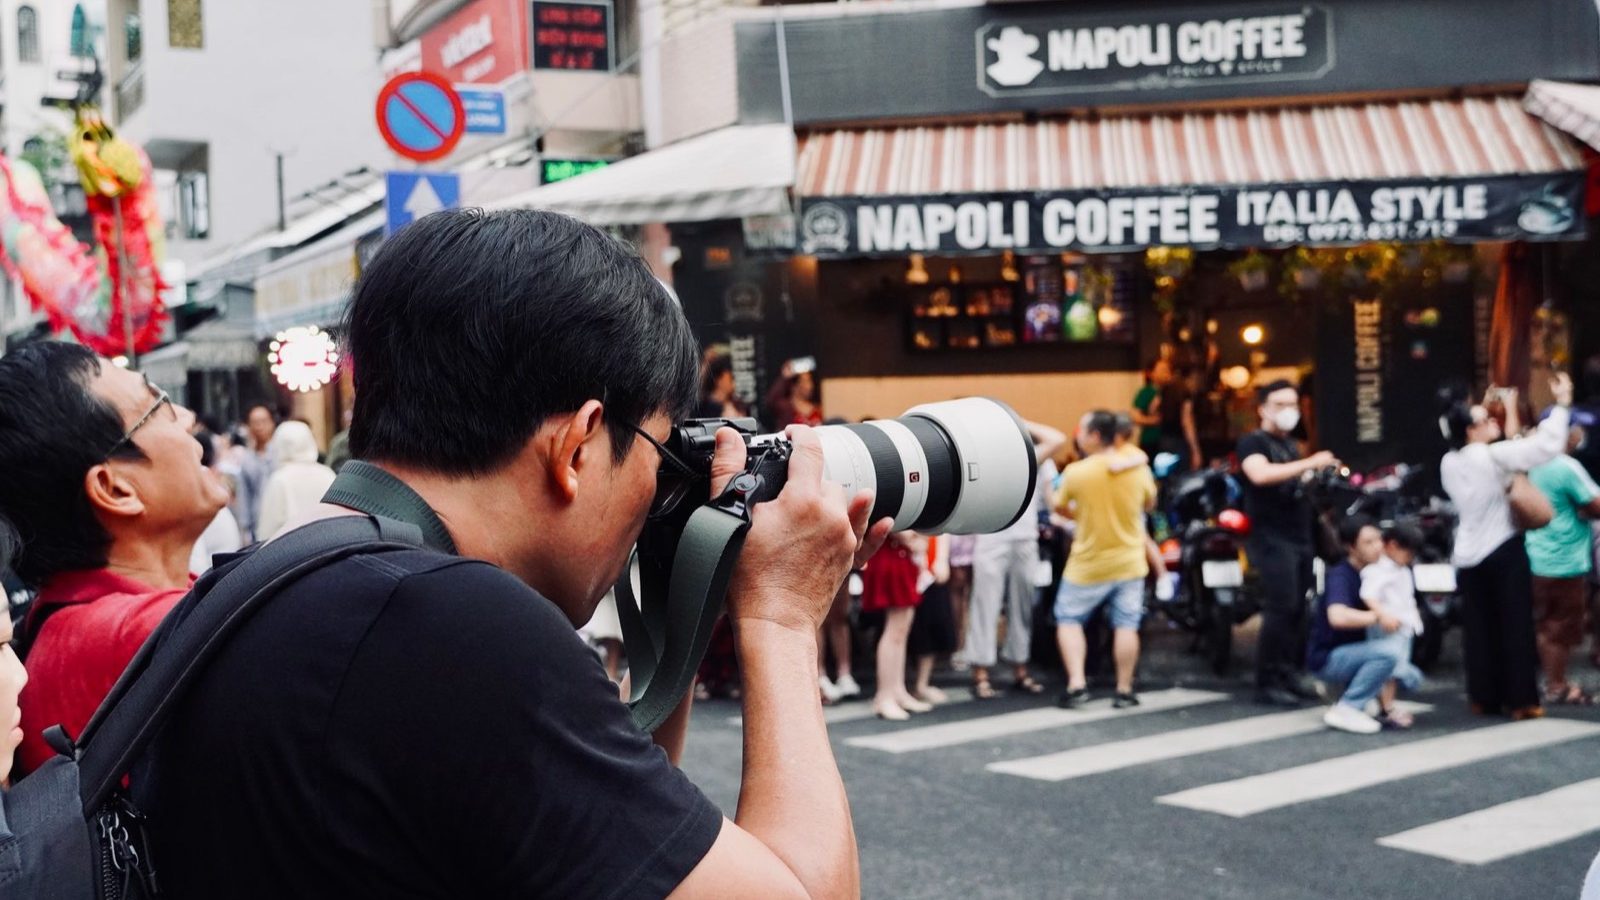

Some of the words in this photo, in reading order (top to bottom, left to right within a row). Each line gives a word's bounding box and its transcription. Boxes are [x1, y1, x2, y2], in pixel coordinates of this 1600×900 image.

[1047, 23, 1171, 71] NAPOLI
[1177, 14, 1307, 65] COFFEE
[857, 200, 1030, 252] NAPOLI
[1041, 195, 1220, 248] COFFEE
[1237, 188, 1362, 225] ITALIA
[1370, 185, 1487, 222] STYLE
[1355, 301, 1381, 369] COFFEE
[1356, 374, 1381, 442] NAPOLI
[910, 472, 919, 482] G
